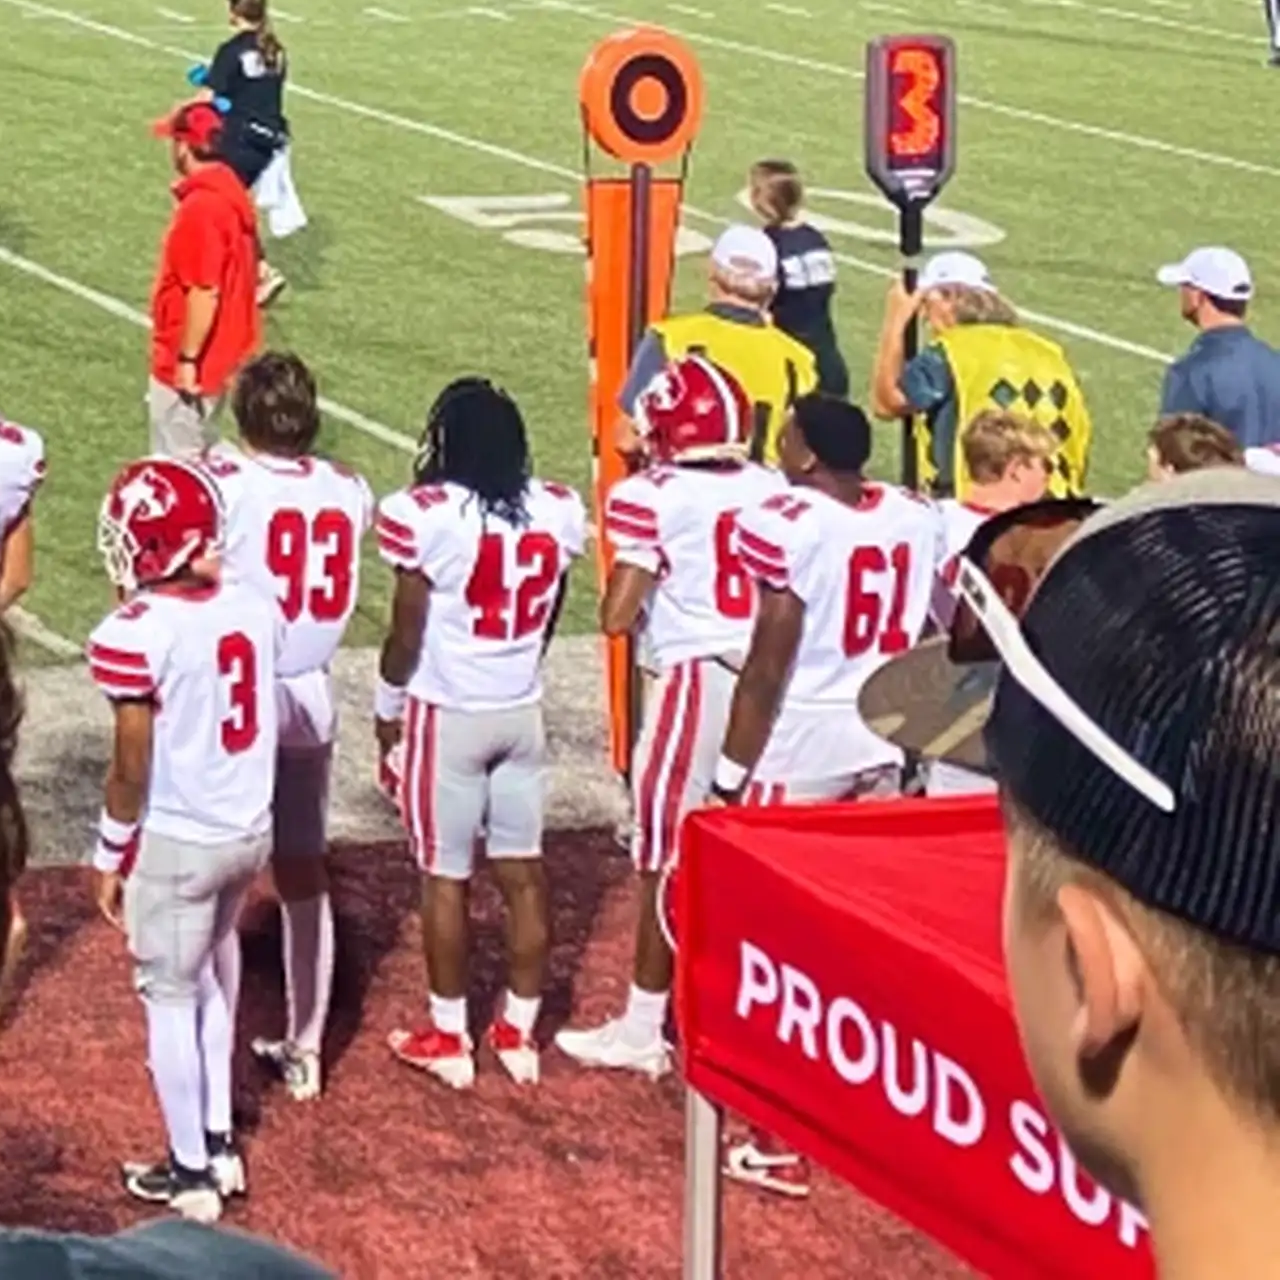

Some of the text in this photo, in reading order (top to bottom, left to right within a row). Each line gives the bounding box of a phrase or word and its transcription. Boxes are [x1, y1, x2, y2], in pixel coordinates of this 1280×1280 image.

[891, 47, 940, 156] 3
[266, 507, 354, 623] 93
[464, 532, 559, 640] 42
[842, 541, 912, 660] 61
[216, 630, 260, 756] 3
[735, 939, 987, 1148] PROUD
